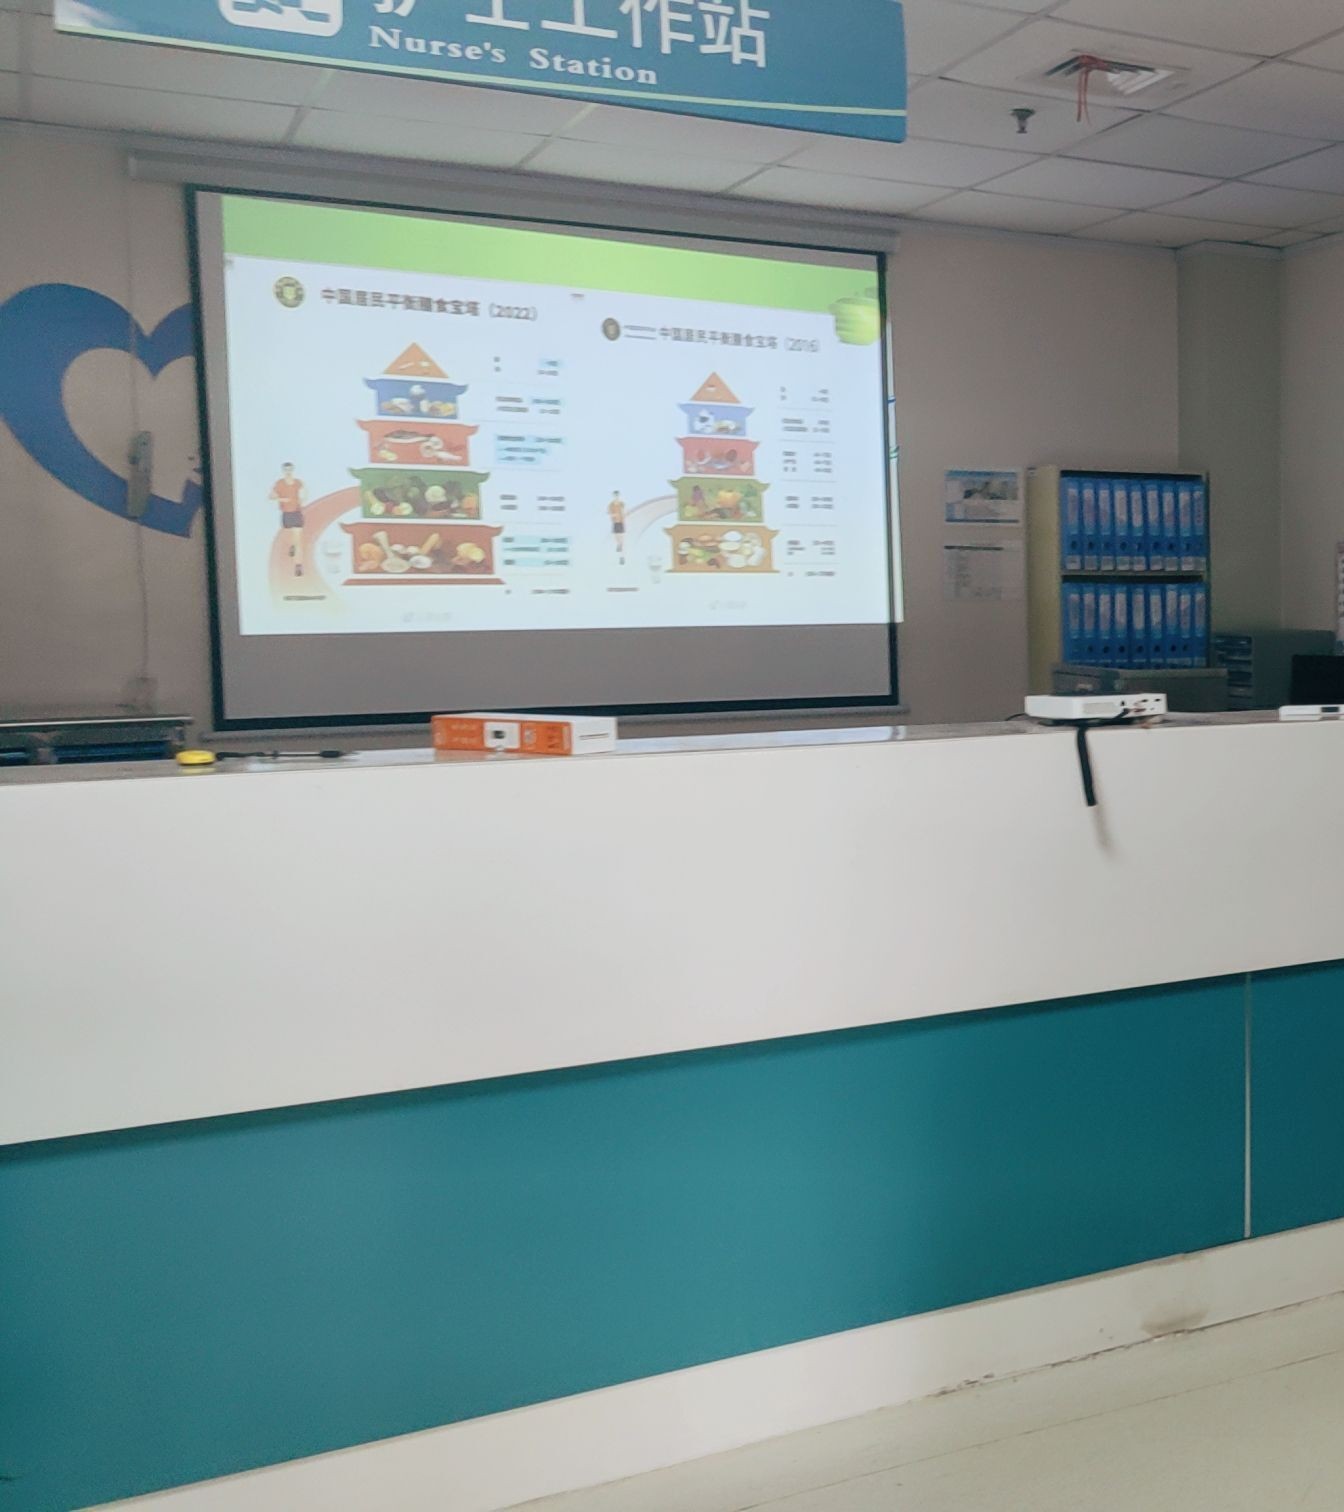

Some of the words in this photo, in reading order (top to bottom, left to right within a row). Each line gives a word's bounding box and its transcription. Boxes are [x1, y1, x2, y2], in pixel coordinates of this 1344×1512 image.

[368, 25, 507, 63] Nurse's
[528, 48, 658, 85] Station
[374, 0, 770, 68] 工作站
